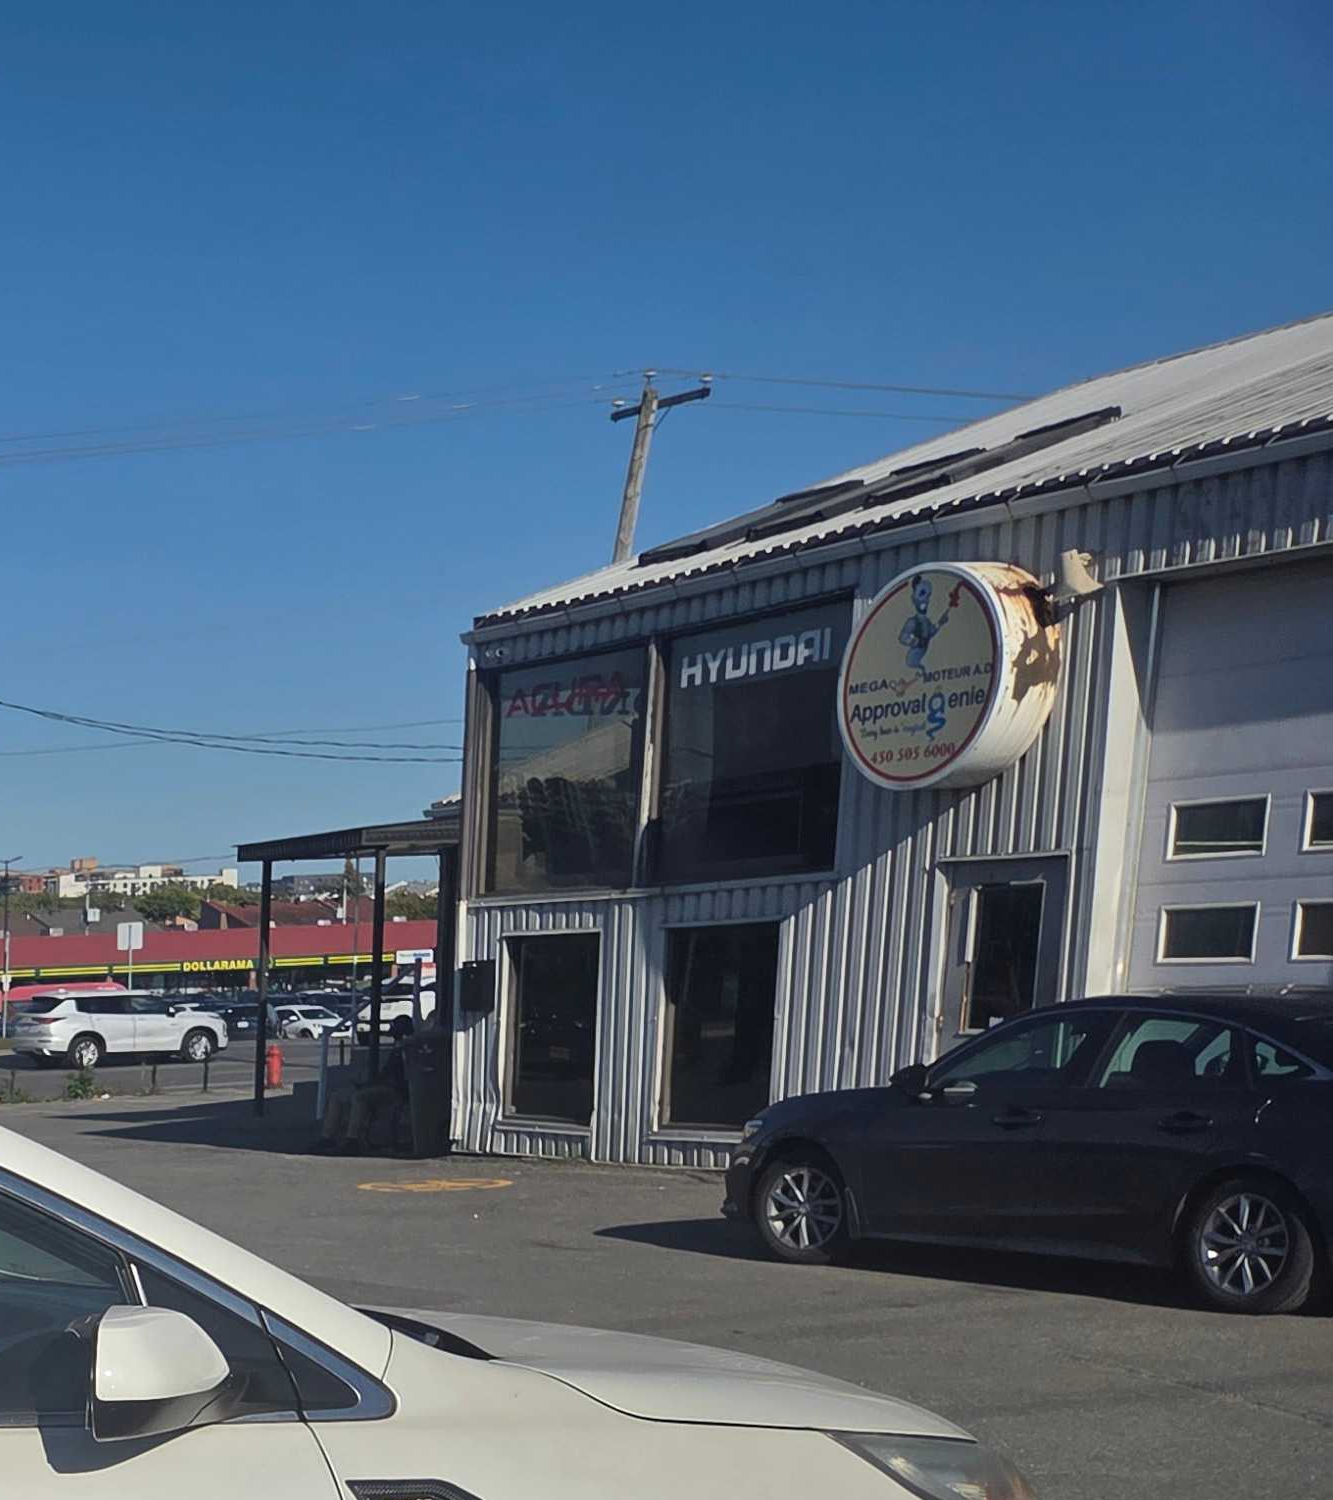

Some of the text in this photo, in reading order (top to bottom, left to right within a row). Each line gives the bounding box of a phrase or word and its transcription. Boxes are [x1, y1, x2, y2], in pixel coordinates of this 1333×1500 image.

[680, 627, 832, 689] HYUNDAI
[849, 678, 890, 696] MEGA
[923, 664, 971, 683] MOTEUR
[850, 693, 926, 726] Approval
[183, 959, 254, 972] DOLLARAMA
